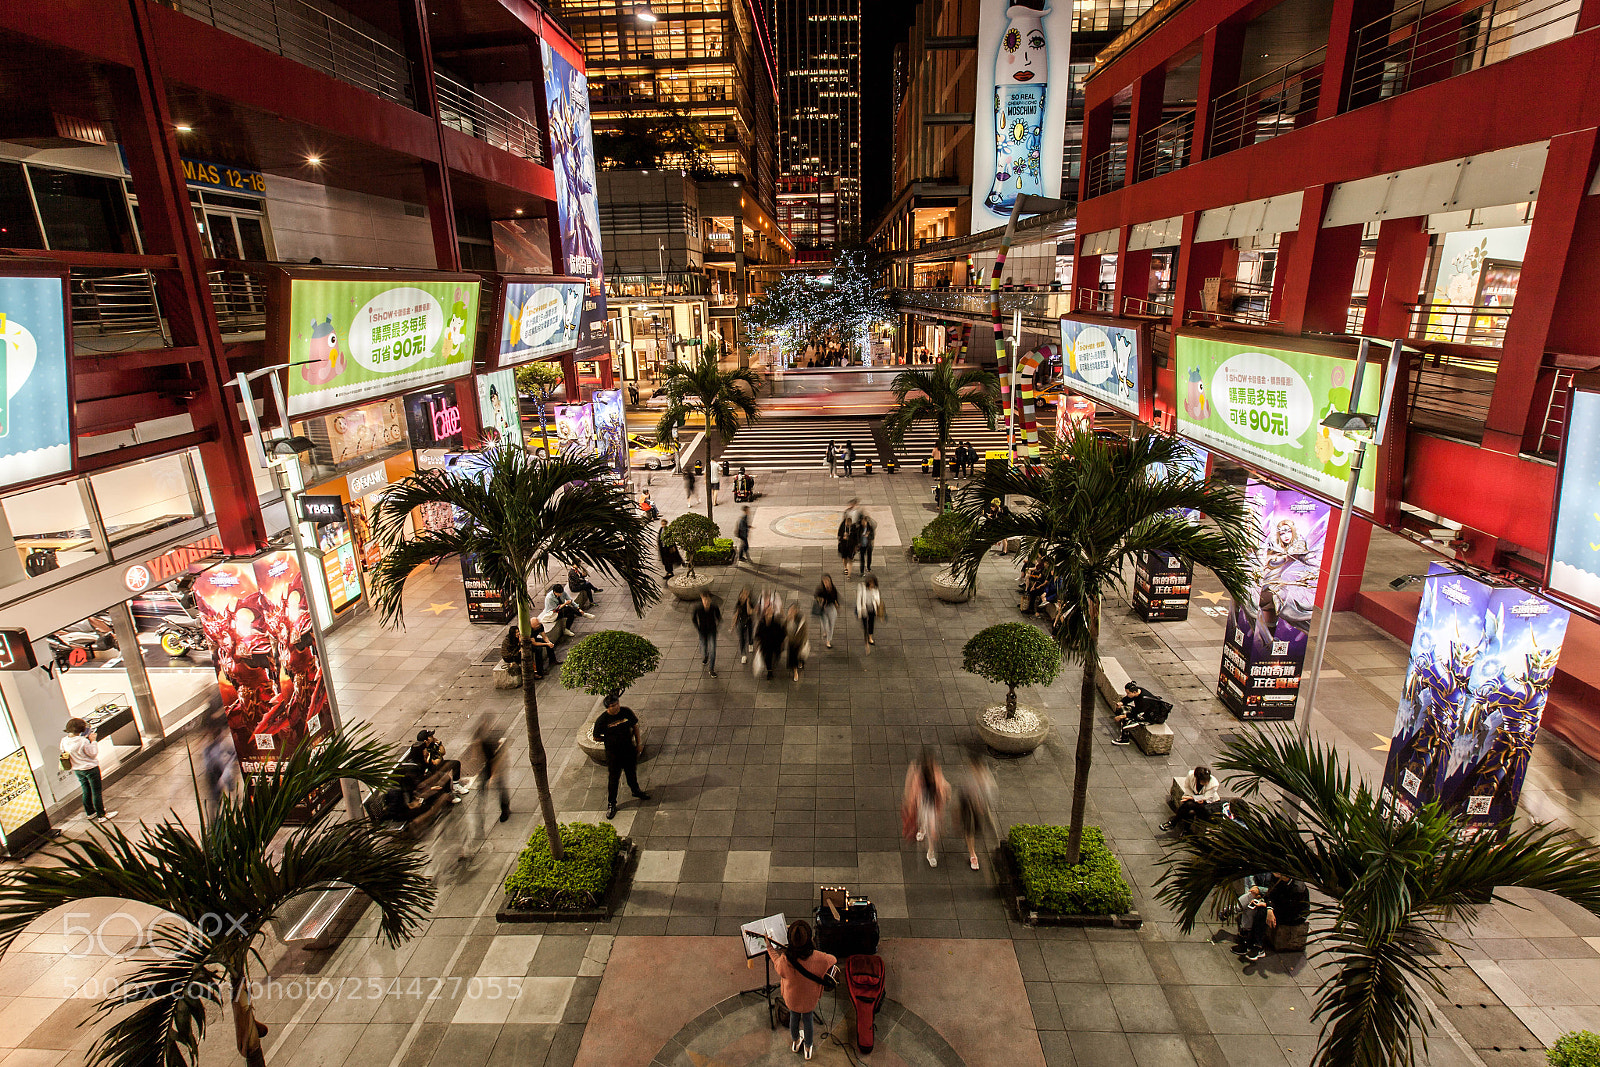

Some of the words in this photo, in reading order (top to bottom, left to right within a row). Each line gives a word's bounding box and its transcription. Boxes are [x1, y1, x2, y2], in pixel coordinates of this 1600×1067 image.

[226, 169, 266, 192] 12-18
[372, 315, 426, 344] 購票最多每張
[1229, 388, 1288, 409] 購票最多每張
[146, 534, 222, 582] YAMAHA
[1250, 666, 1296, 676] 你的奇蹟
[1252, 676, 1301, 688] 正在覺醒
